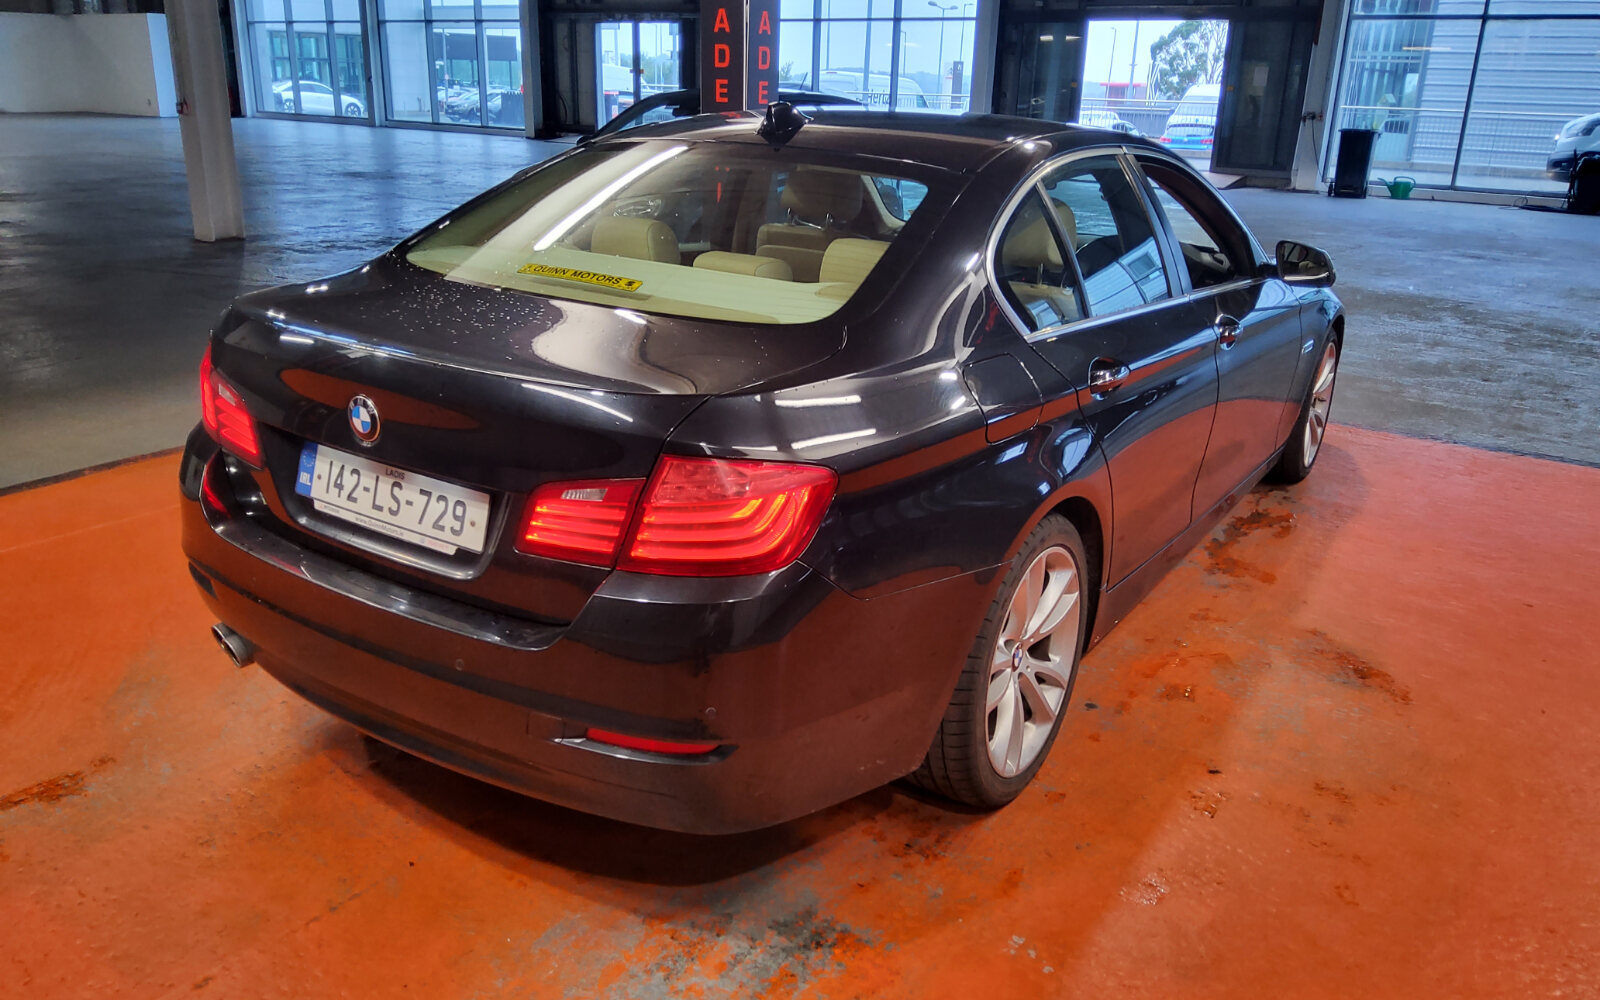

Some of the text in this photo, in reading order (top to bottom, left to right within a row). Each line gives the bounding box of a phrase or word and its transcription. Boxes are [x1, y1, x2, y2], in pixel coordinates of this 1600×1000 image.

[533, 264, 623, 286] QUINN MOTORS
[299, 471, 312, 486] IRL
[325, 460, 468, 537] 142-LS-729
